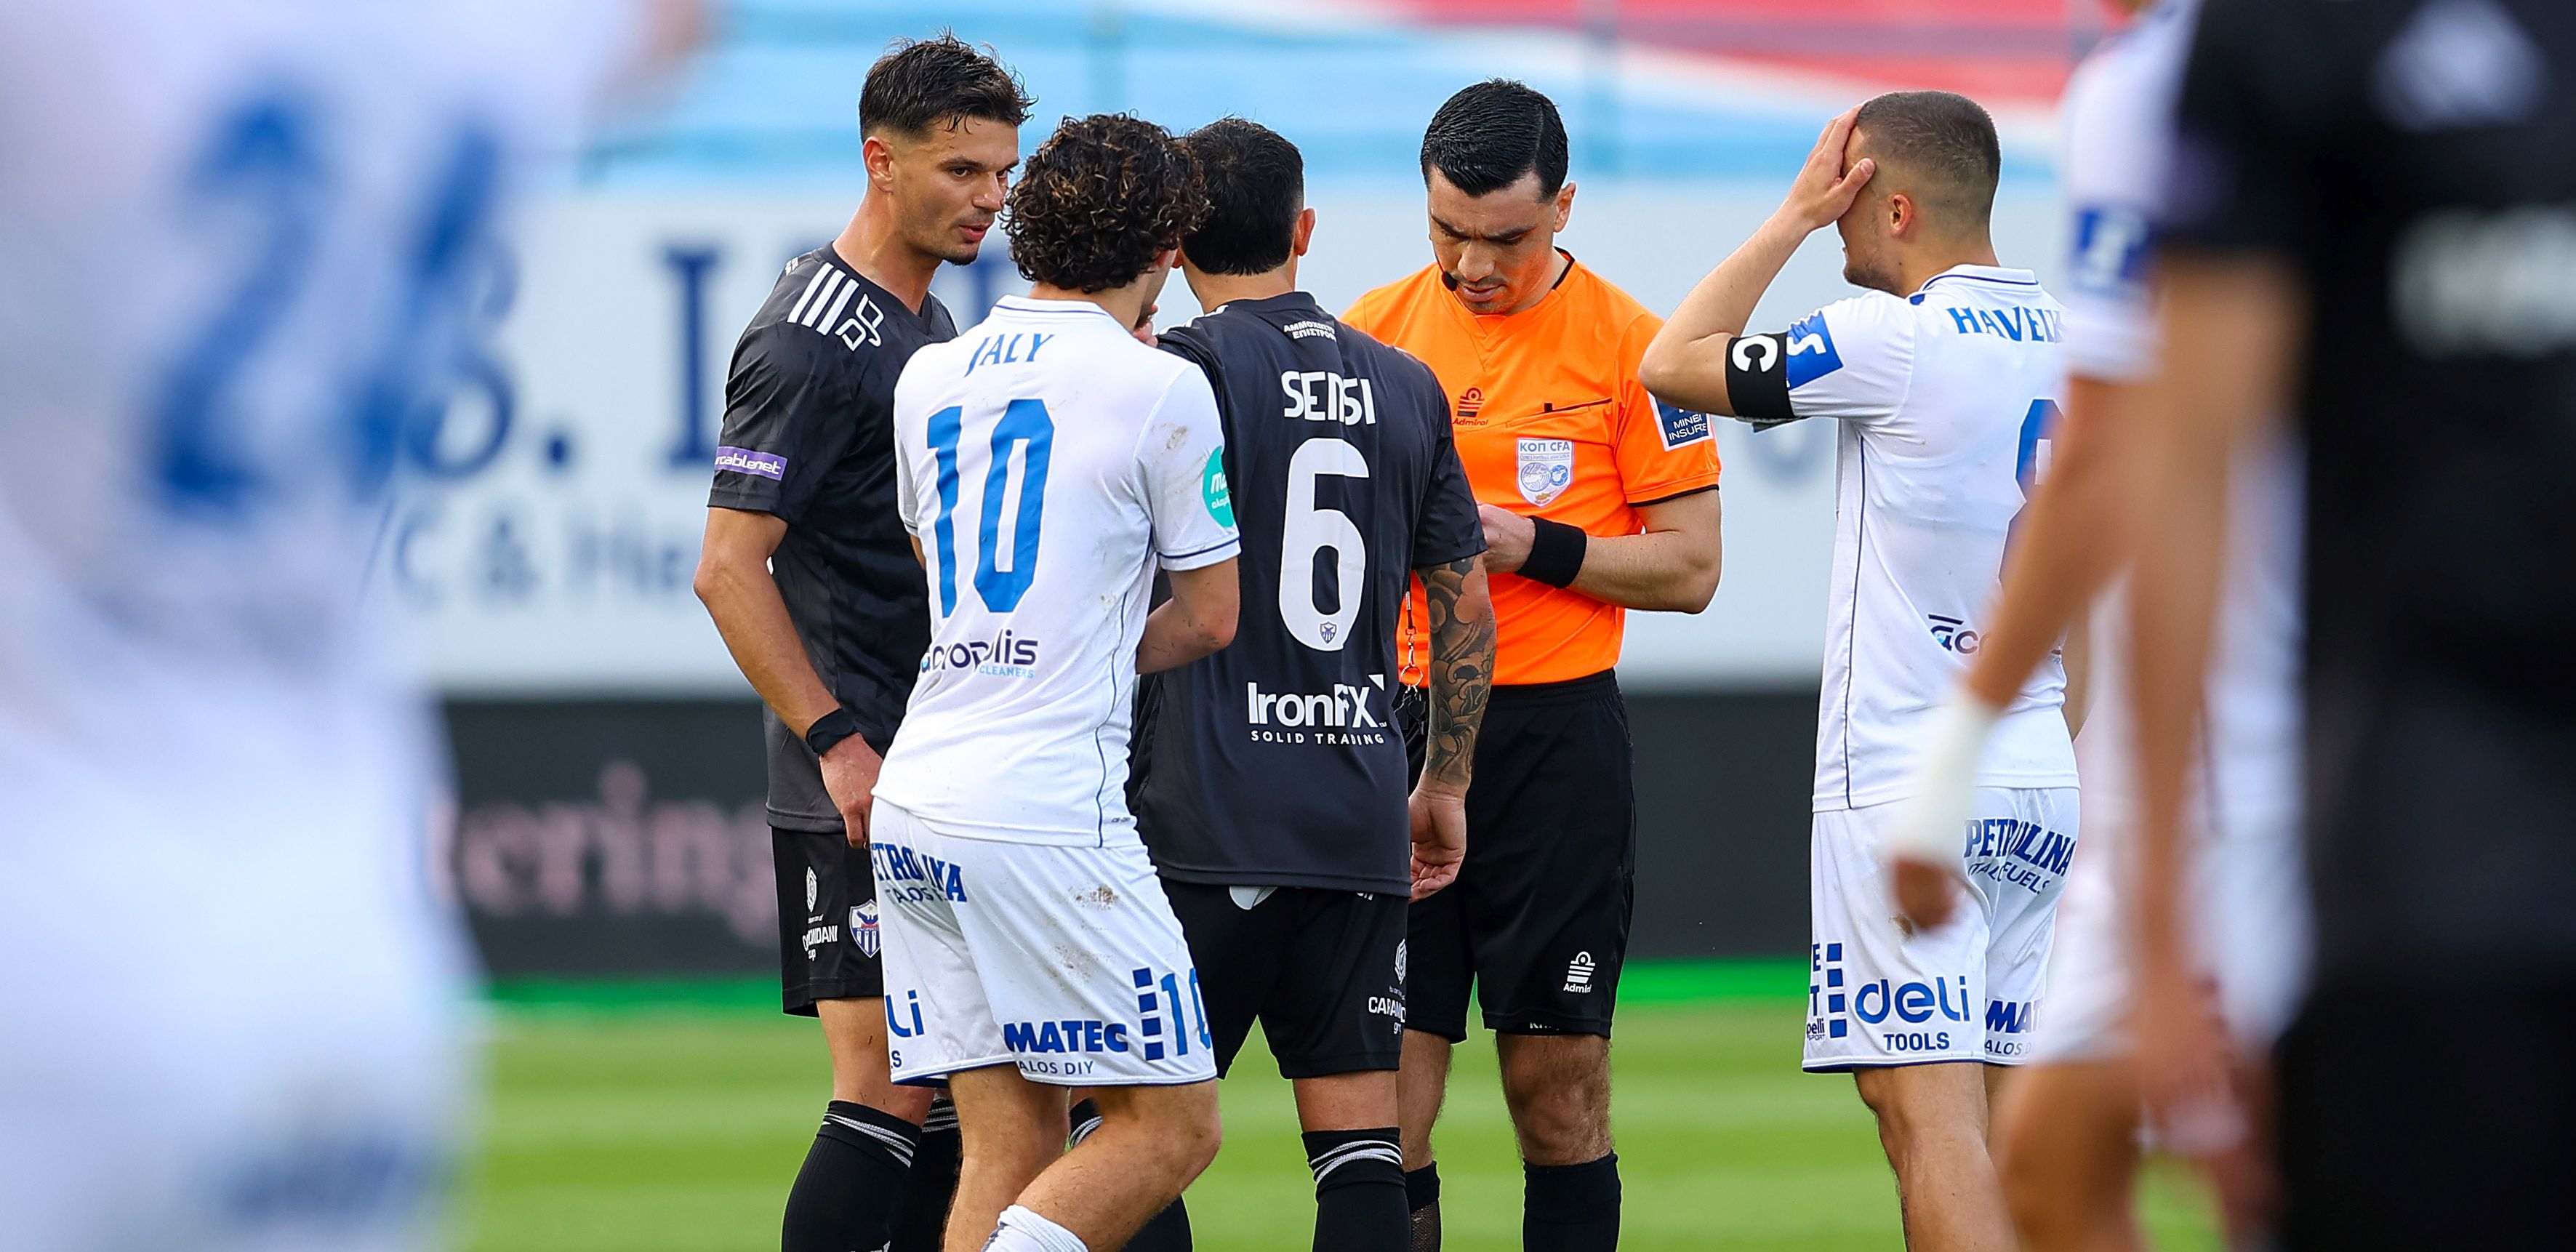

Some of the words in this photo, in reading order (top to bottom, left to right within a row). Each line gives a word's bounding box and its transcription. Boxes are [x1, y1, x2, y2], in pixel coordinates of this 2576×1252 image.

[1946, 306, 2063, 344] HAVELK
[964, 334, 1054, 378] JALY
[1281, 370, 1376, 425] SENSI
[1550, 441, 1570, 452] CFA
[927, 398, 1054, 618] 10
[1279, 438, 1370, 651] 6
[921, 629, 1038, 674] acroplis
[980, 665, 1035, 678] CLEANERS
[1251, 730, 1304, 744] SOLID
[1315, 733, 1384, 746] TRADING
[886, 989, 925, 1038] li
[1855, 976, 1970, 1024] deli
[1985, 1000, 2045, 1033] MAT
[1004, 1021, 1128, 1053] MATEC
[1806, 1017, 1825, 1038] pelli
[1883, 1032, 1950, 1051] TOOLS
[1065, 1061, 1094, 1075] DIY
